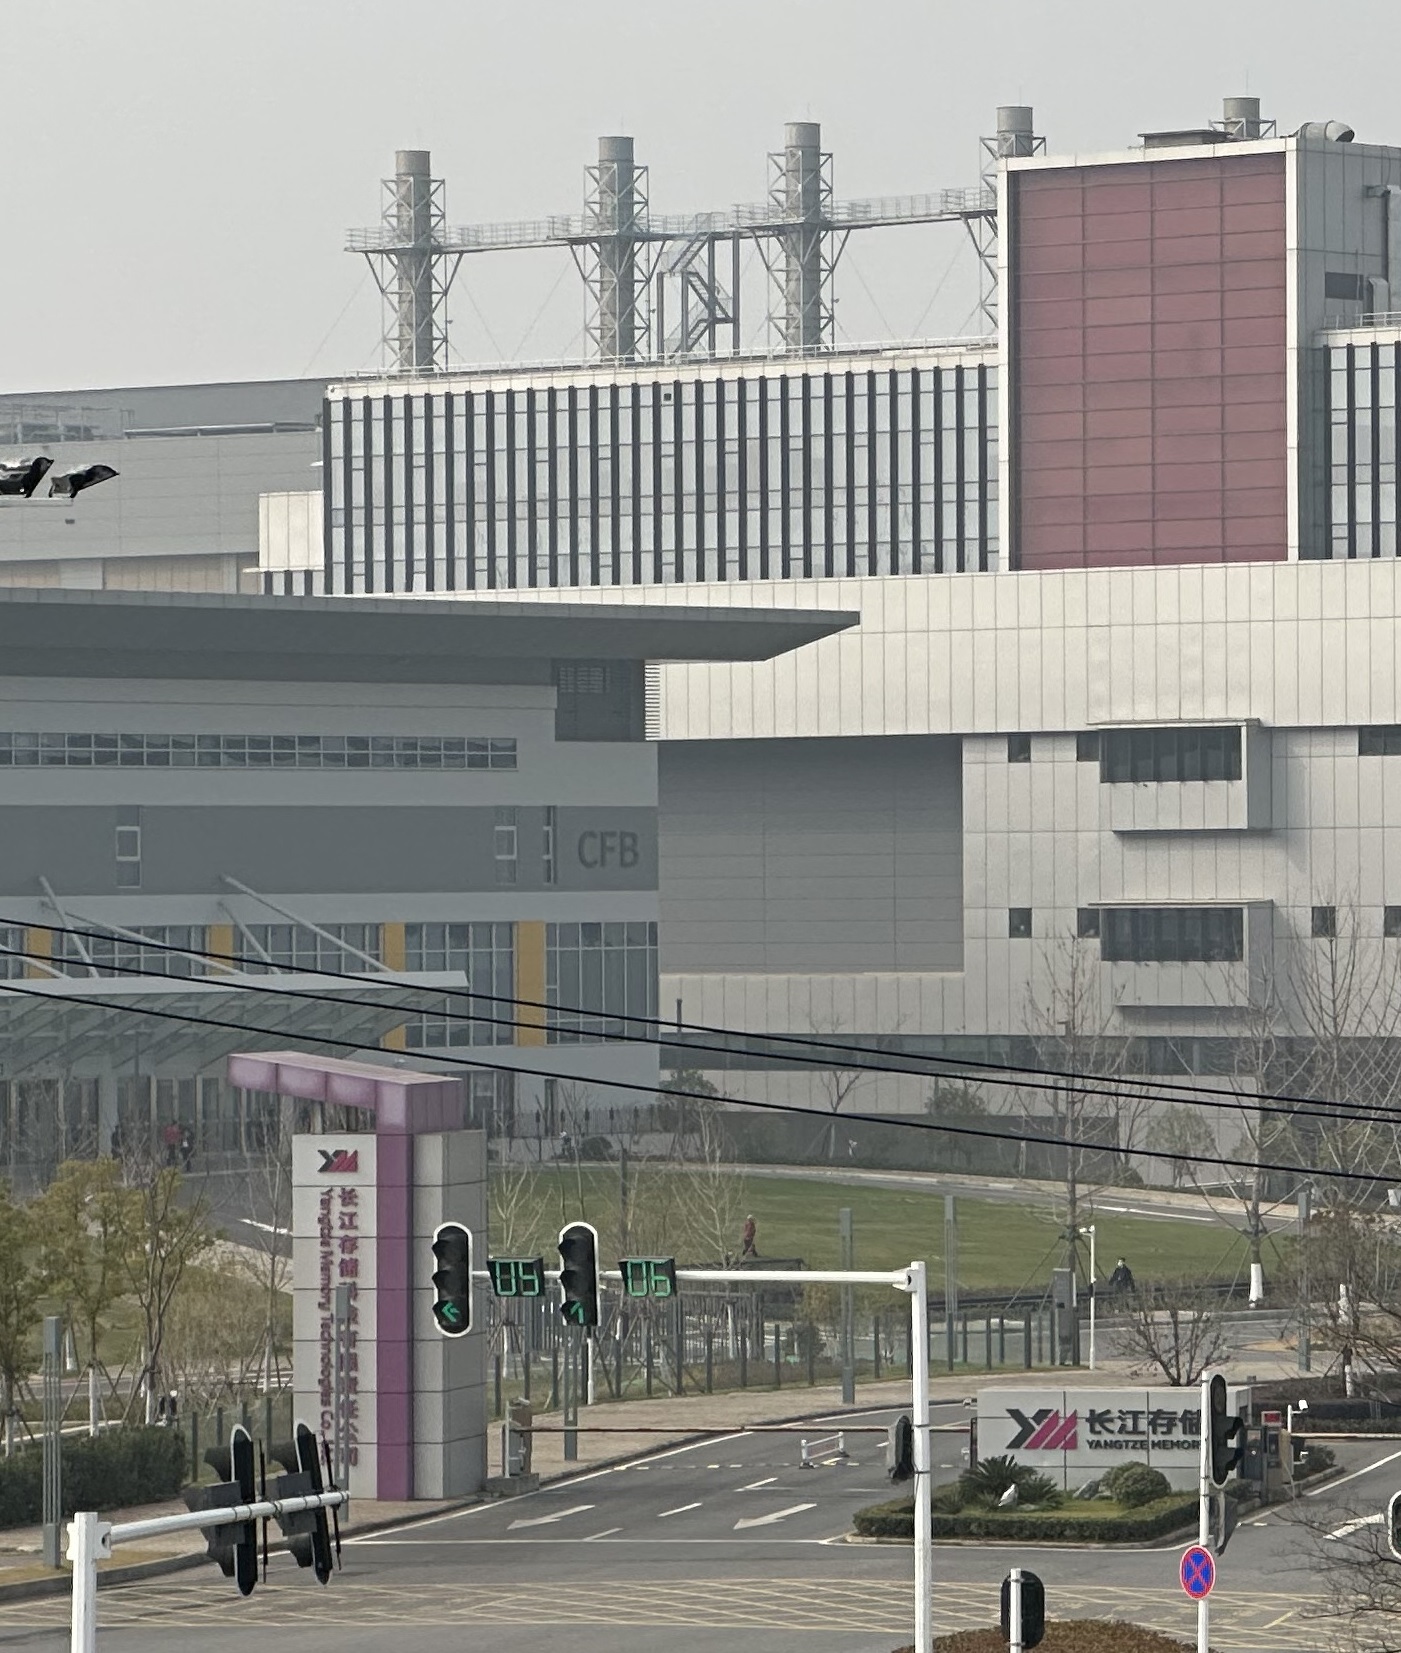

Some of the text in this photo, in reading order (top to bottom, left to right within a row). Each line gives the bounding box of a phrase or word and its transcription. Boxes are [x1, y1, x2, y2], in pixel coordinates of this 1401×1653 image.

[578, 830, 639, 868] CFB
[318, 1250, 334, 1311] Memory
[626, 1260, 671, 1297] 06
[1086, 1439, 1202, 1450] YANGTZE MEMOR
